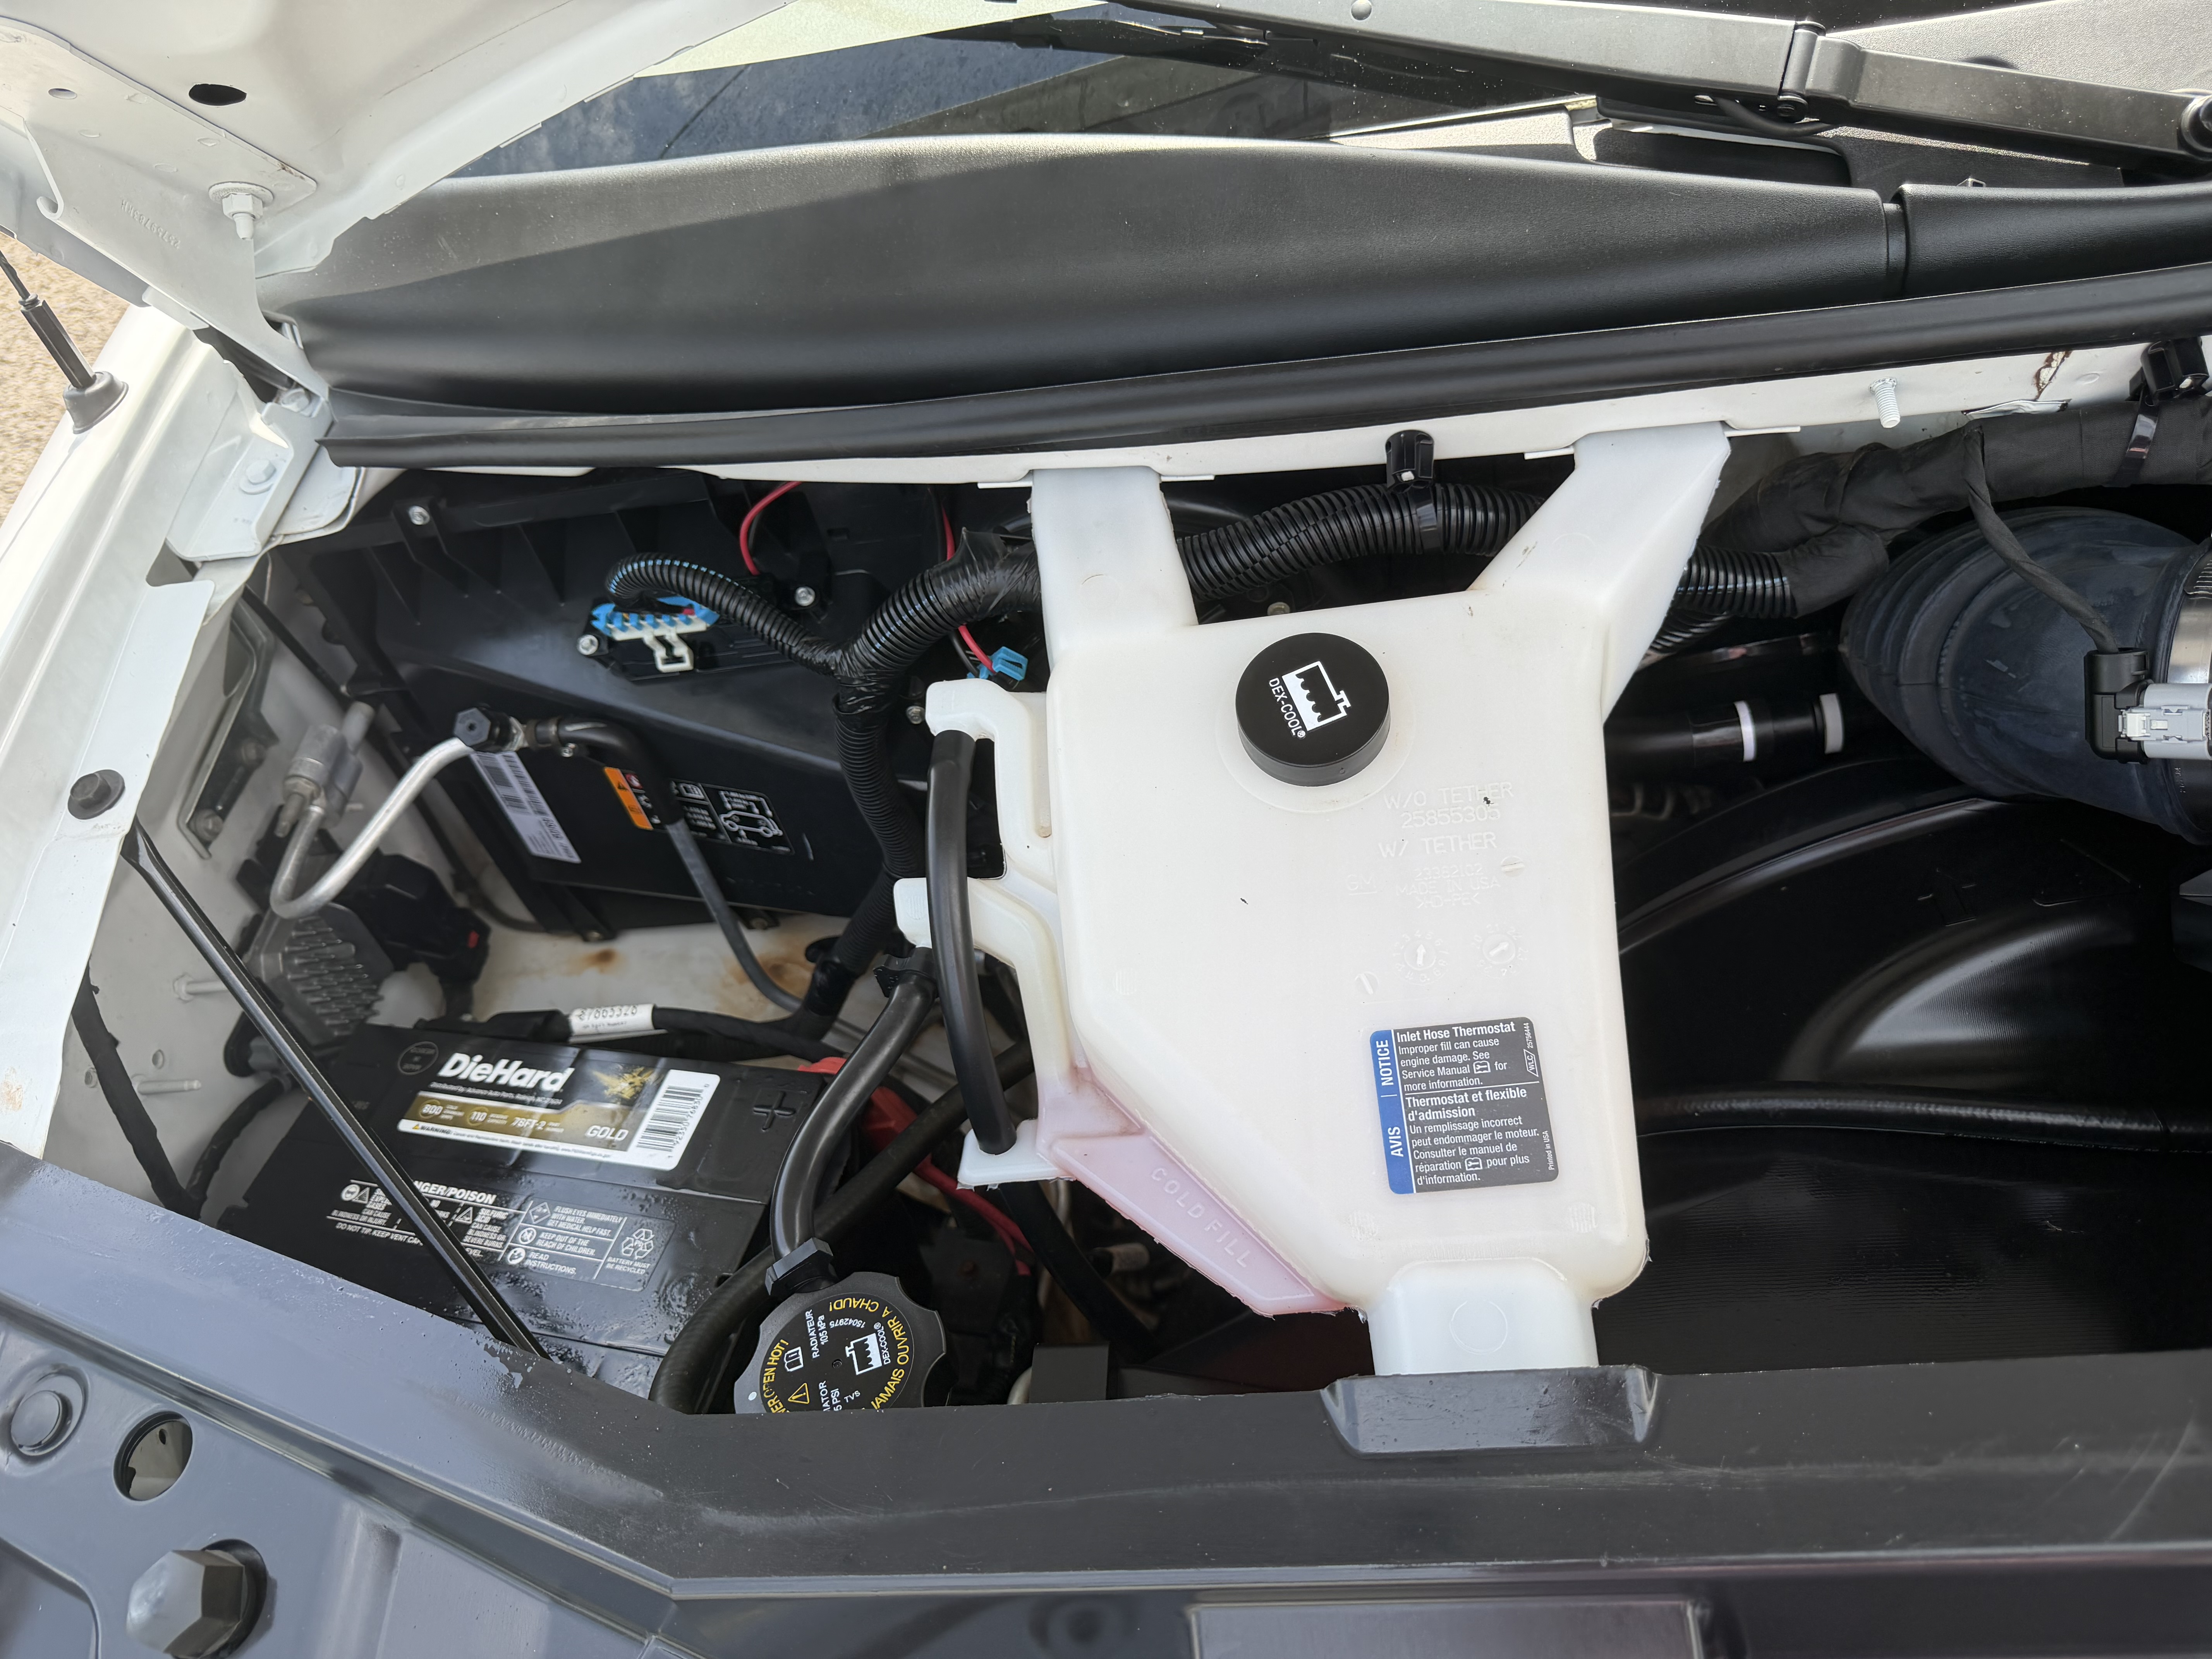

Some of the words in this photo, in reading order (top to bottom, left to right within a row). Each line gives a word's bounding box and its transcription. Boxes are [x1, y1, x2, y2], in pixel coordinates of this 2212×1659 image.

[1383, 790, 1427, 809] W/O
[1437, 782, 1514, 804] TETHER
[1400, 804, 1501, 829] 25855305
[1378, 840, 1408, 858] W/
[1420, 831, 1497, 854] TETHER
[1396, 881, 1438, 896] MADE
[1471, 876, 1501, 890] USA
[1397, 1031, 1421, 1042] Inlet
[1423, 1029, 1450, 1040] Hose
[1452, 1022, 1516, 1037] Thermostat
[1398, 1044, 1438, 1055] Improper
[1440, 1041, 1452, 1051] fill
[1454, 1041, 1470, 1049] can
[1473, 1038, 1499, 1048] cause
[1376, 1040, 1394, 1086] NOTICE
[1400, 1056, 1430, 1067] engine
[1432, 1054, 1470, 1063] damage.
[1473, 1051, 1490, 1060] See
[1527, 1055, 1535, 1071] WLC
[437, 1053, 575, 1092] DieHard
[1402, 1068, 1435, 1079] Service
[1437, 1064, 1470, 1076] Manual
[1494, 1061, 1507, 1070] for
[1404, 1082, 1426, 1091] more
[1429, 1077, 1483, 1089] information.
[1405, 1092, 1469, 1108] Thermostat
[1472, 1091, 1483, 1101] et
[1485, 1087, 1527, 1101] flexible
[1408, 1106, 1475, 1121] d'admission
[585, 1125, 629, 1141] GOLD
[1409, 1125, 1422, 1134] Un
[1424, 1121, 1479, 1133] remplissage
[1481, 1116, 1523, 1128] incorrect
[1388, 1127, 1403, 1157] AVIS
[1412, 1137, 1432, 1148] peut
[1434, 1133, 1492, 1147] endommager
[1494, 1130, 1503, 1139] le
[1505, 1128, 1539, 1139] moteur.
[1413, 1148, 1456, 1159] Consulter
[1458, 1147, 1467, 1156] le
[1470, 1143, 1503, 1155] manuel
[1506, 1142, 1517, 1152] de
[1415, 1161, 1462, 1173] réparation
[1486, 1158, 1507, 1168] pour
[1510, 1155, 1530, 1166] plus
[1546, 1150, 1554, 1170] Printed
[1417, 1172, 1480, 1185] d'information.
[1150, 1167, 1204, 1218] COLD
[1204, 1218, 1252, 1267] FILL
[528, 1252, 549, 1261] READ
[830, 1298, 879, 1312] CHAUD!
[882, 1306, 893, 1317] A
[830, 1318, 866, 1328] 15042975
[805, 1309, 820, 1358] RADIATEUR
[819, 1330, 829, 1345] 105
[887, 1316, 909, 1365] OUVRIR
[767, 1339, 789, 1365] HOT!
[763, 1367, 777, 1398] OPEN
[831, 1388, 841, 1405] PSI
[844, 1390, 861, 1403] TVS
